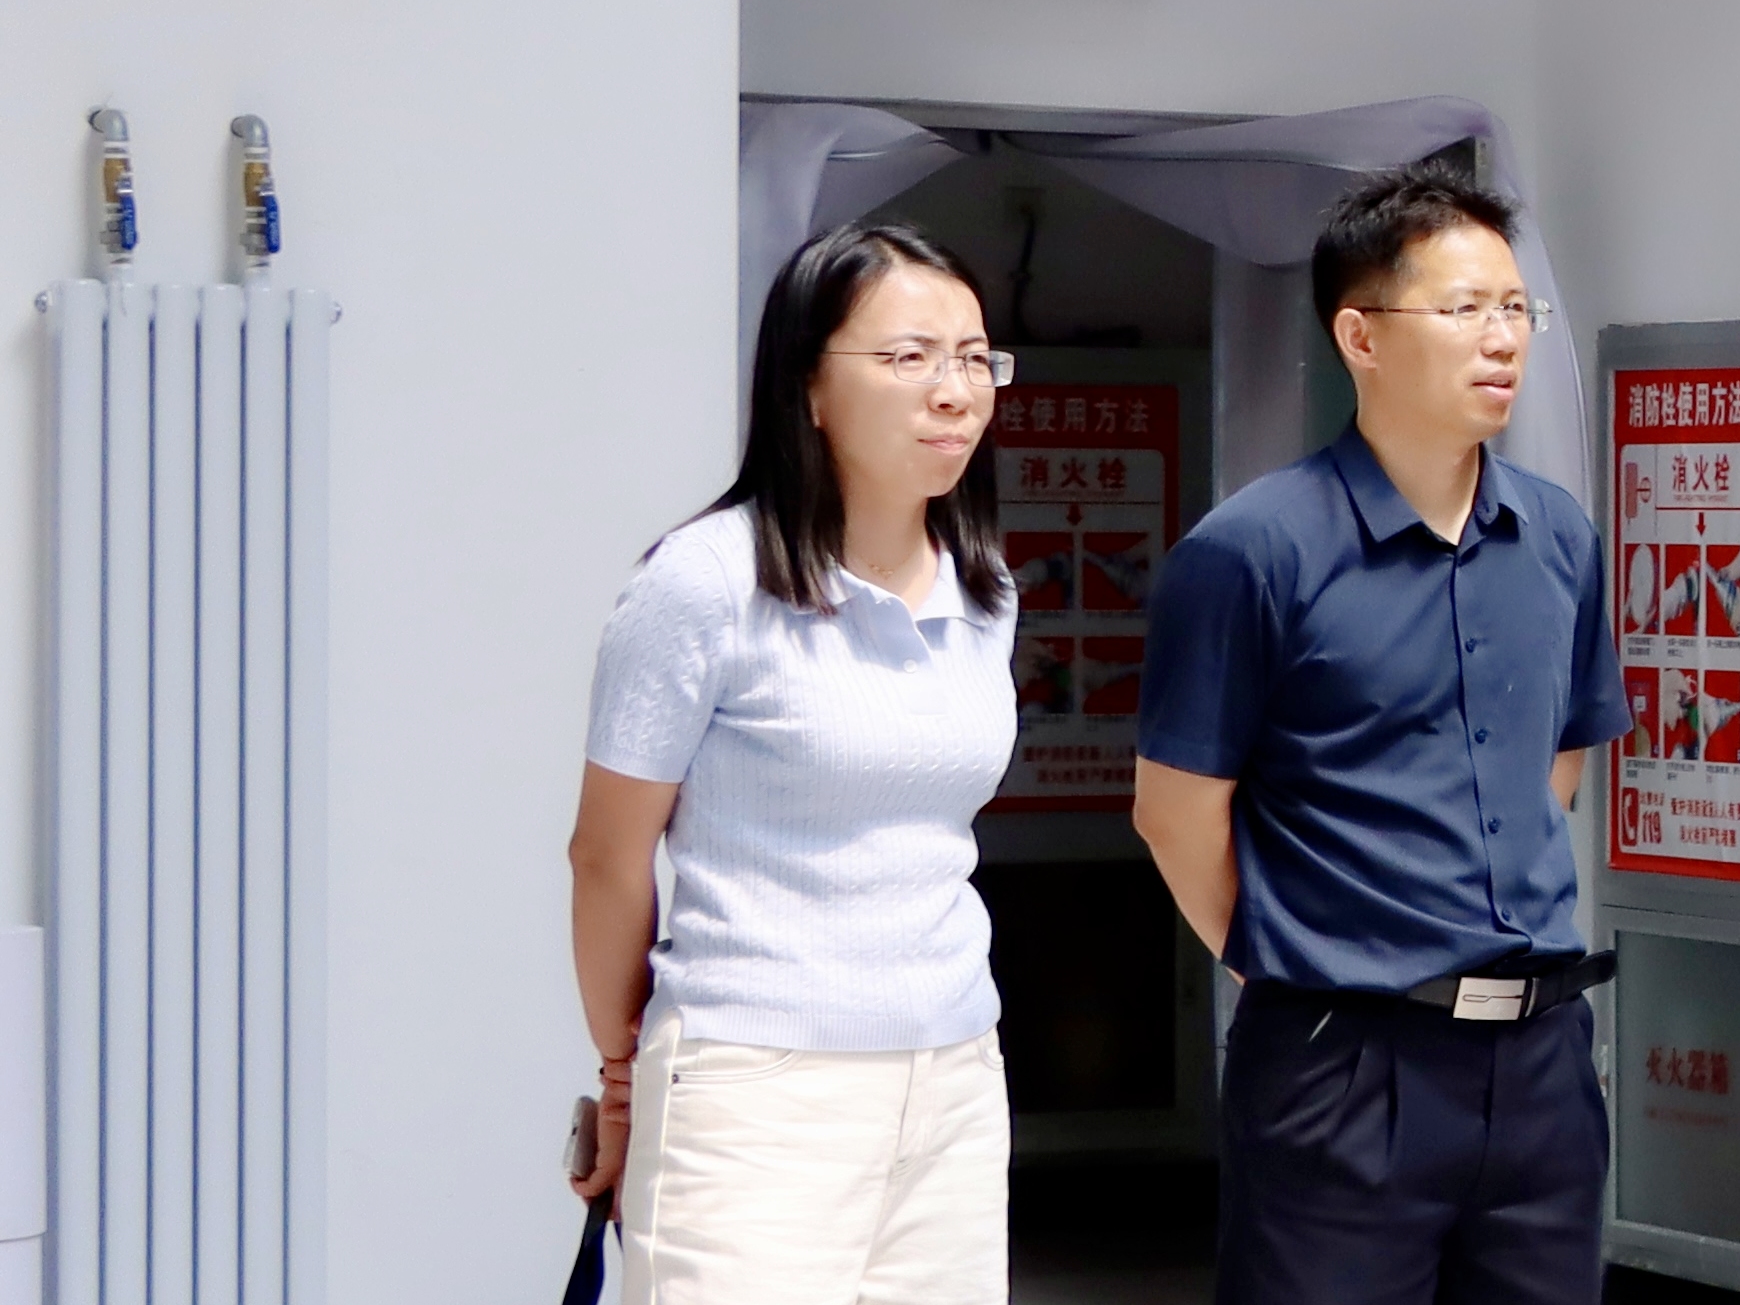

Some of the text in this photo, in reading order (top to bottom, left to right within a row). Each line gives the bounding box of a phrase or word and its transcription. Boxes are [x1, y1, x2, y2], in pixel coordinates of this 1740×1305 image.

[1020, 456, 1126, 489] 消火栓
[1673, 453, 1729, 492] 消火栓
[1642, 811, 1662, 844] 119
